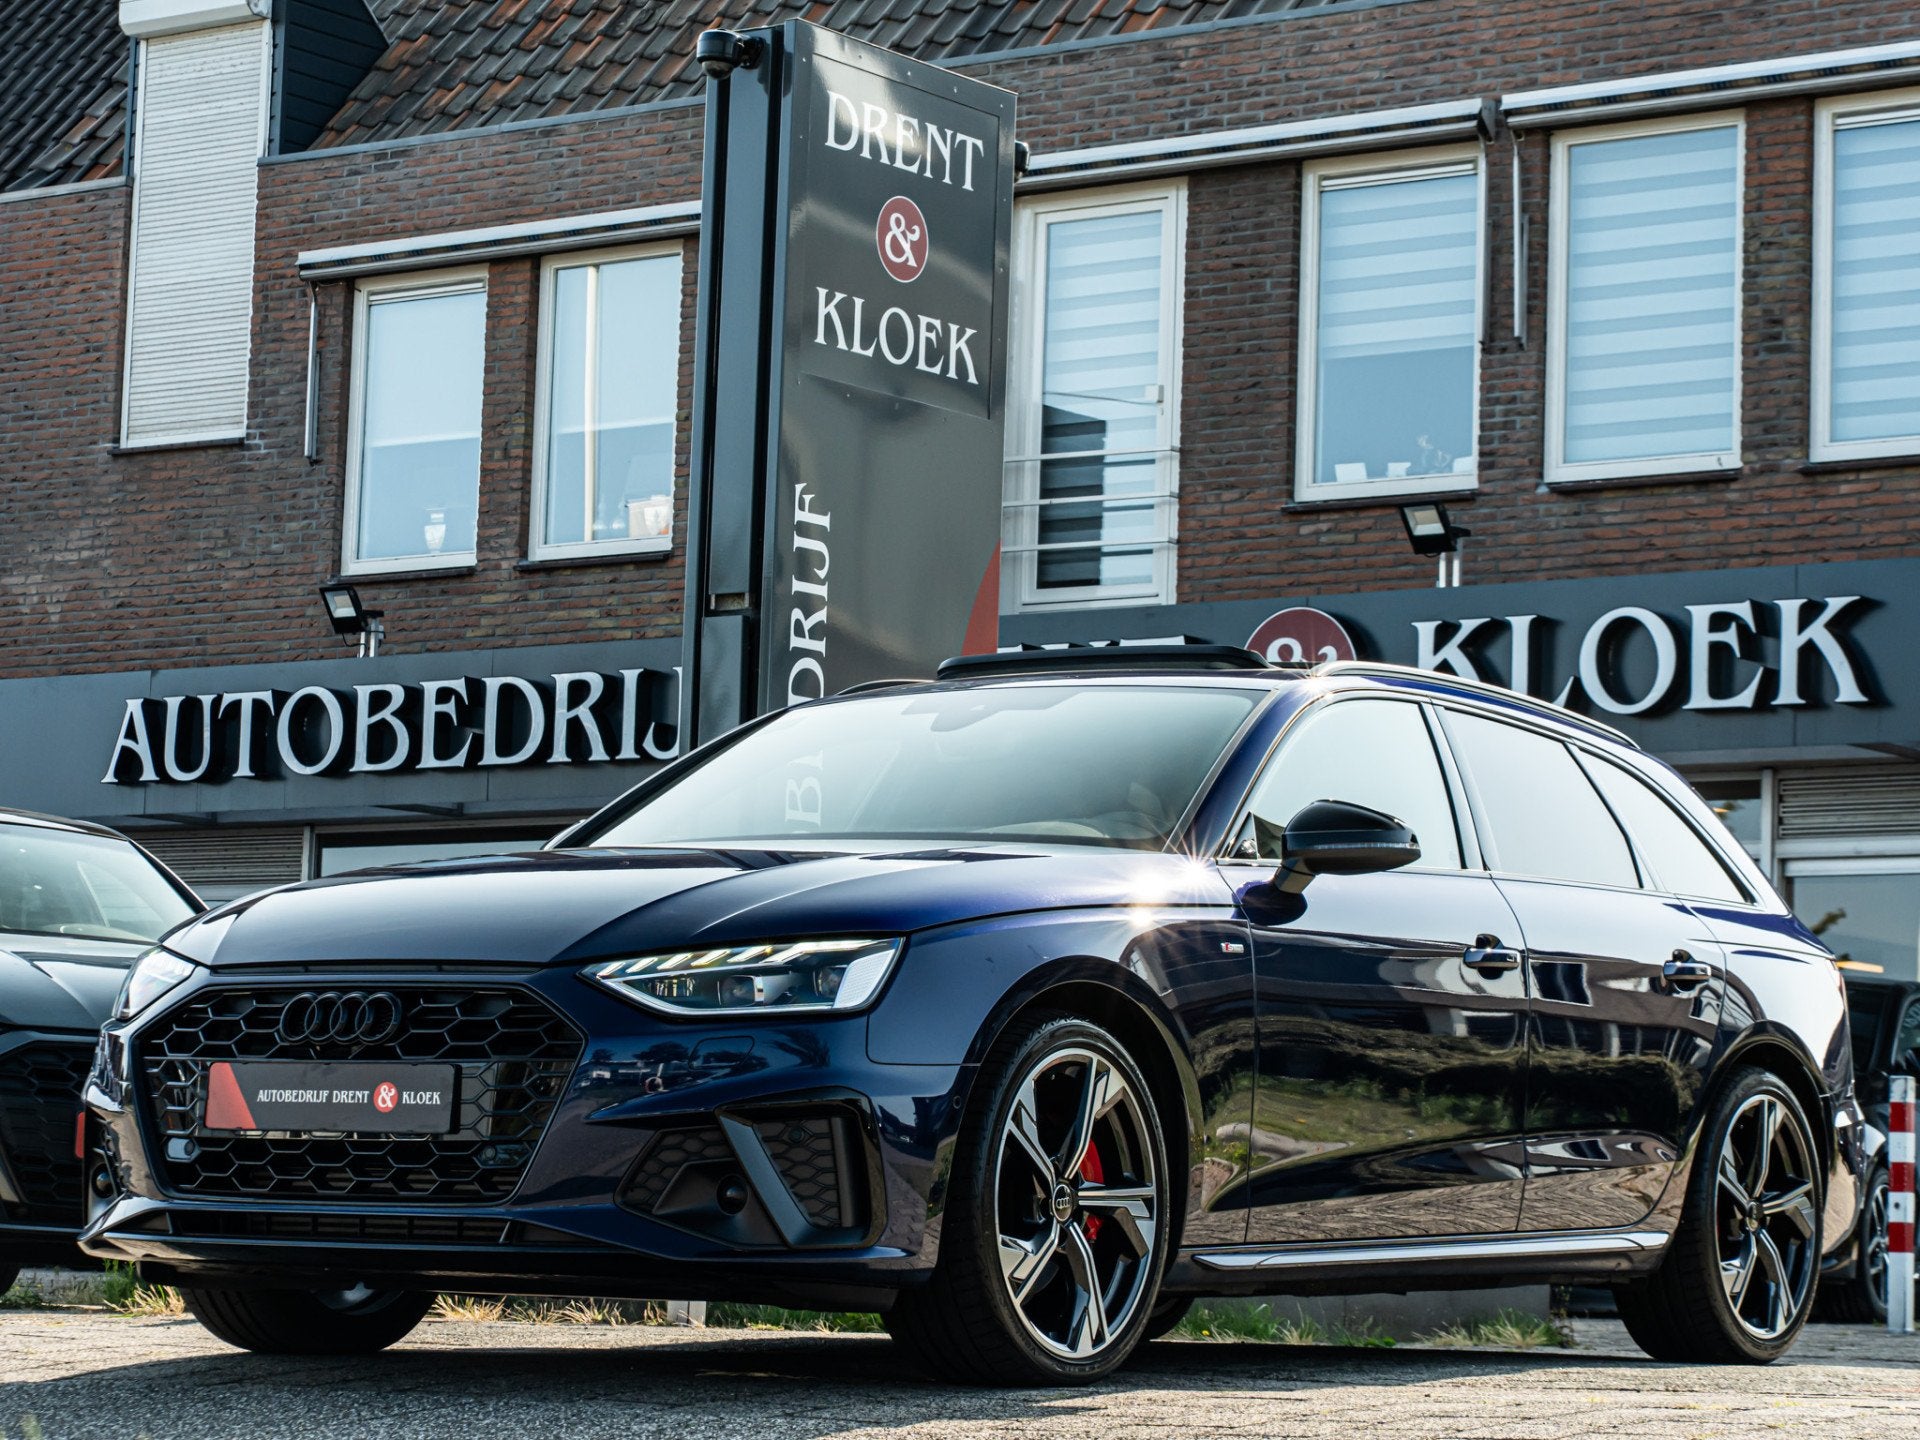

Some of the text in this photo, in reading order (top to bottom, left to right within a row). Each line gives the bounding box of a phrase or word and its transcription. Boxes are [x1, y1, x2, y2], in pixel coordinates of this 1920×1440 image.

[824, 89, 985, 192] DRENT
[884, 212, 921, 268] &
[813, 286, 980, 386] KLOEK
[100, 595, 1869, 784] AUTOBEDRIJ KLOEK
[257, 1084, 441, 1108] AUTOBEDRIJF DRENT & KLOEK
